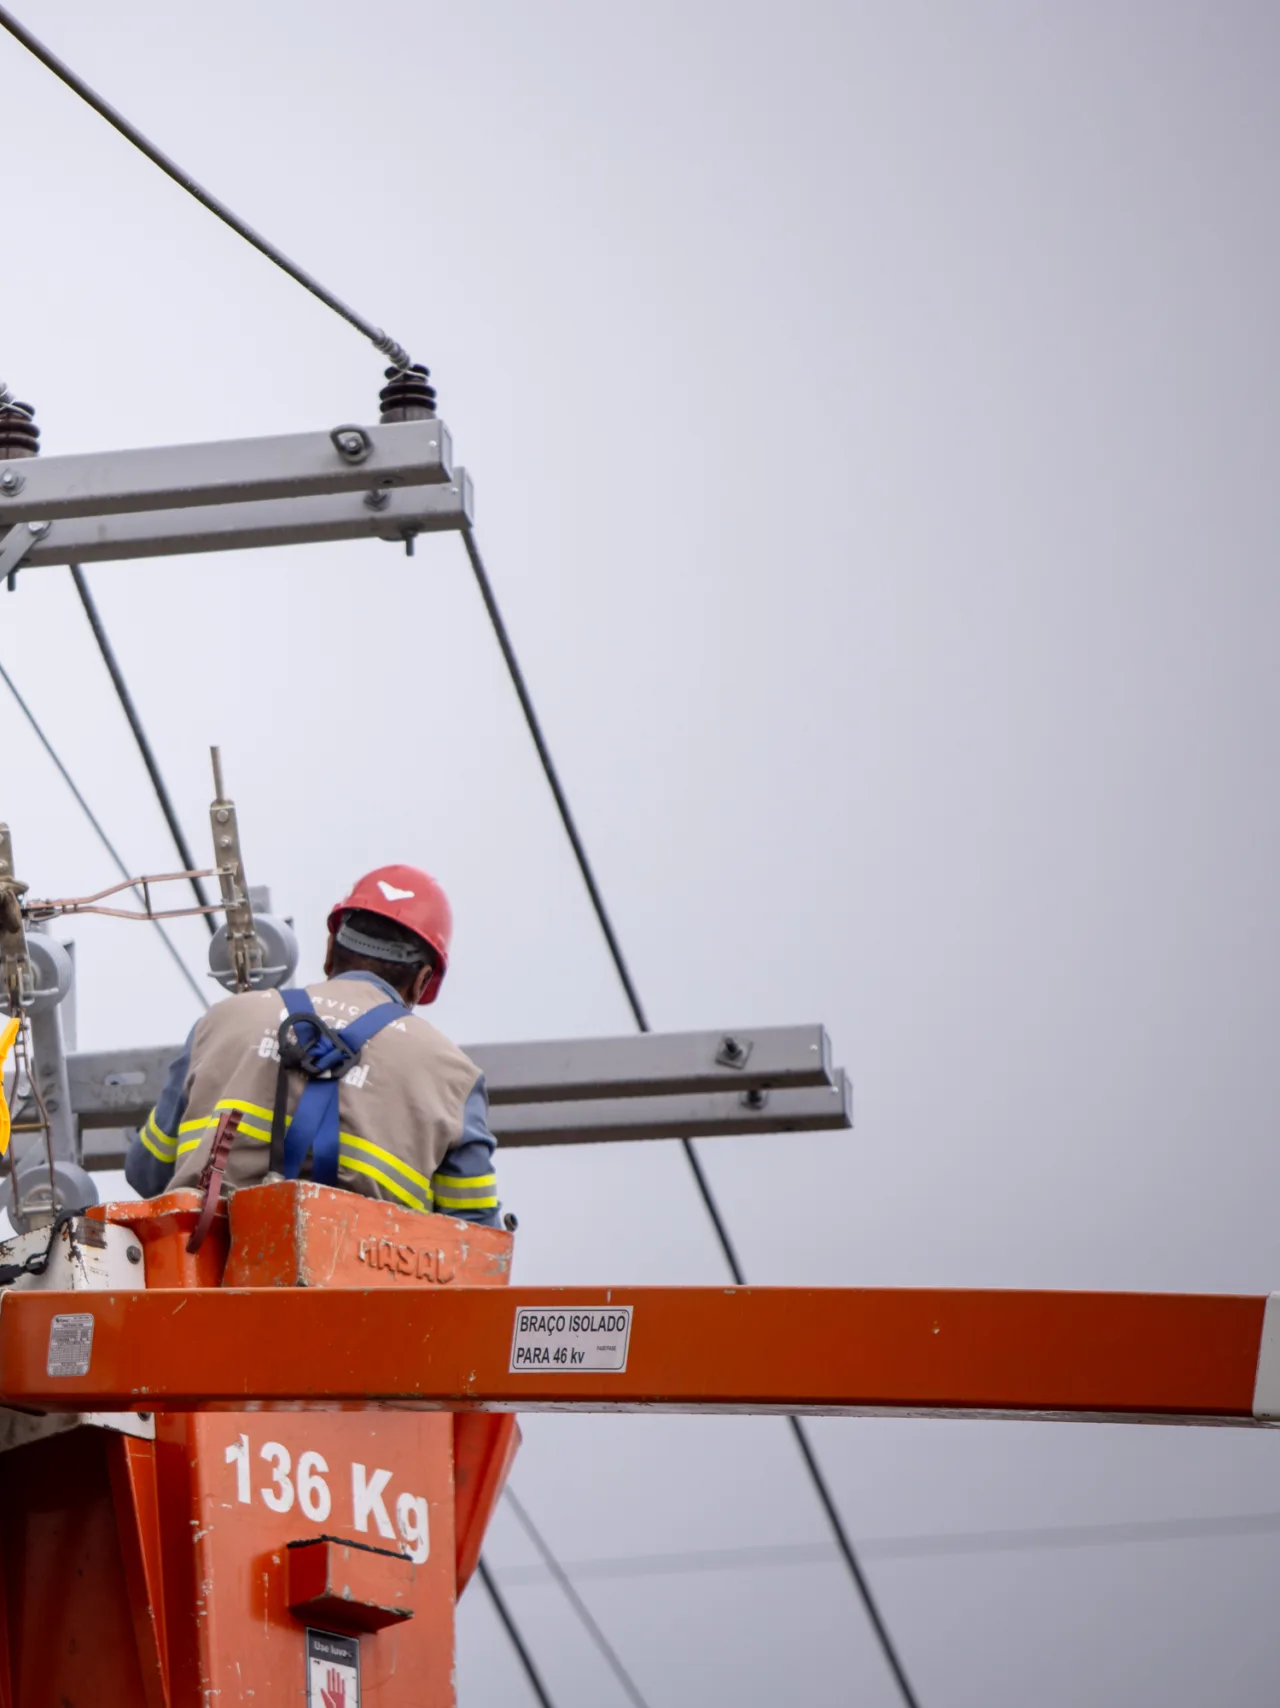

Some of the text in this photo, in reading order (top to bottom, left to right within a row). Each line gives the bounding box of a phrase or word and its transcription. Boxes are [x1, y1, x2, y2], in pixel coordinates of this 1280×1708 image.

[520, 1315, 626, 1336] BRAÇO ISOLADO
[516, 1347, 585, 1364] PARA 46 kv
[225, 1433, 429, 1564] 136 Kg
[314, 1641, 329, 1653] Use
